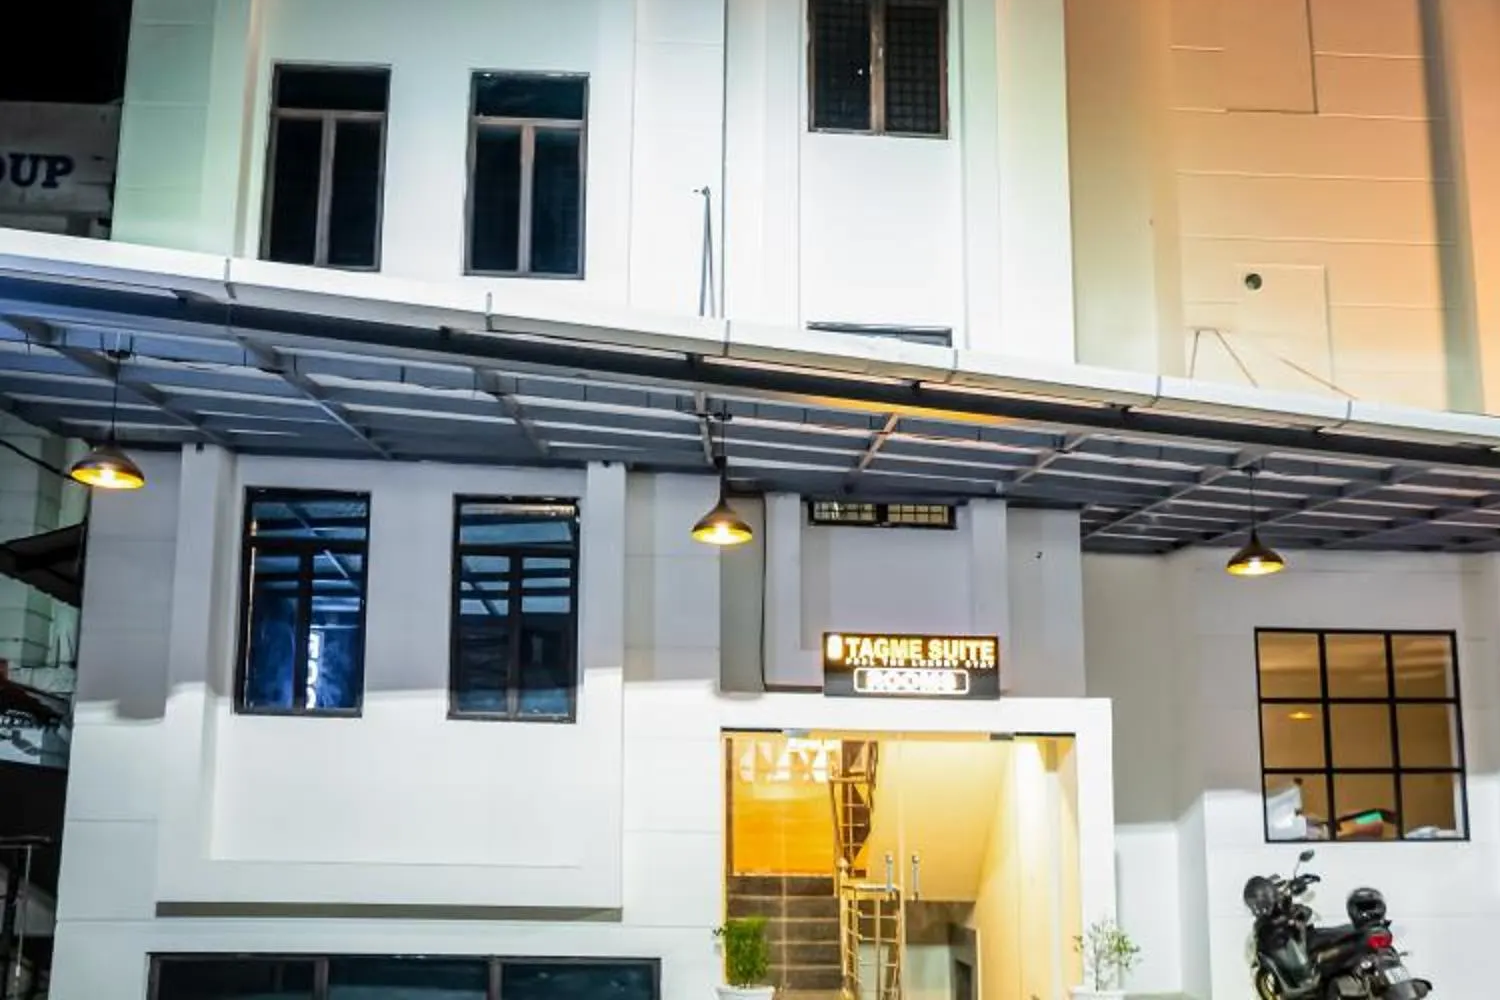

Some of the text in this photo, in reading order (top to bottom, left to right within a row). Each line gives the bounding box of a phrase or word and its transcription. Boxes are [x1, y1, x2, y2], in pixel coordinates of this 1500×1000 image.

[0, 153, 74, 188] UP
[845, 637, 995, 662] TAGME SUITE
